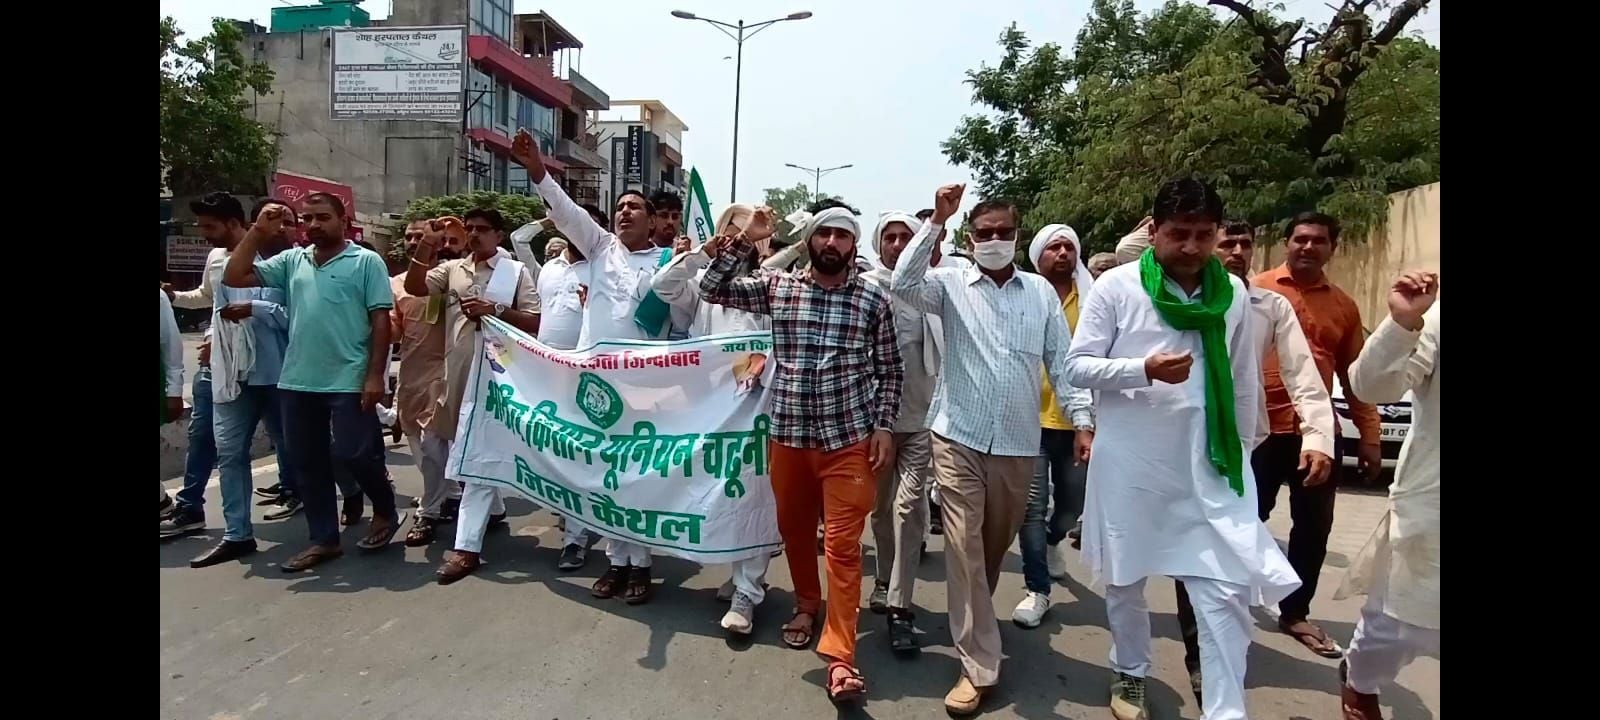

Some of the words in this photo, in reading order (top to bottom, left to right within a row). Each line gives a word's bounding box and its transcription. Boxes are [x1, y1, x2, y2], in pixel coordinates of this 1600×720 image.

[720, 342, 747, 352] जय
[600, 420, 700, 491] यूनियन
[514, 454, 583, 515] जिला
[588, 491, 706, 545] कैथल
